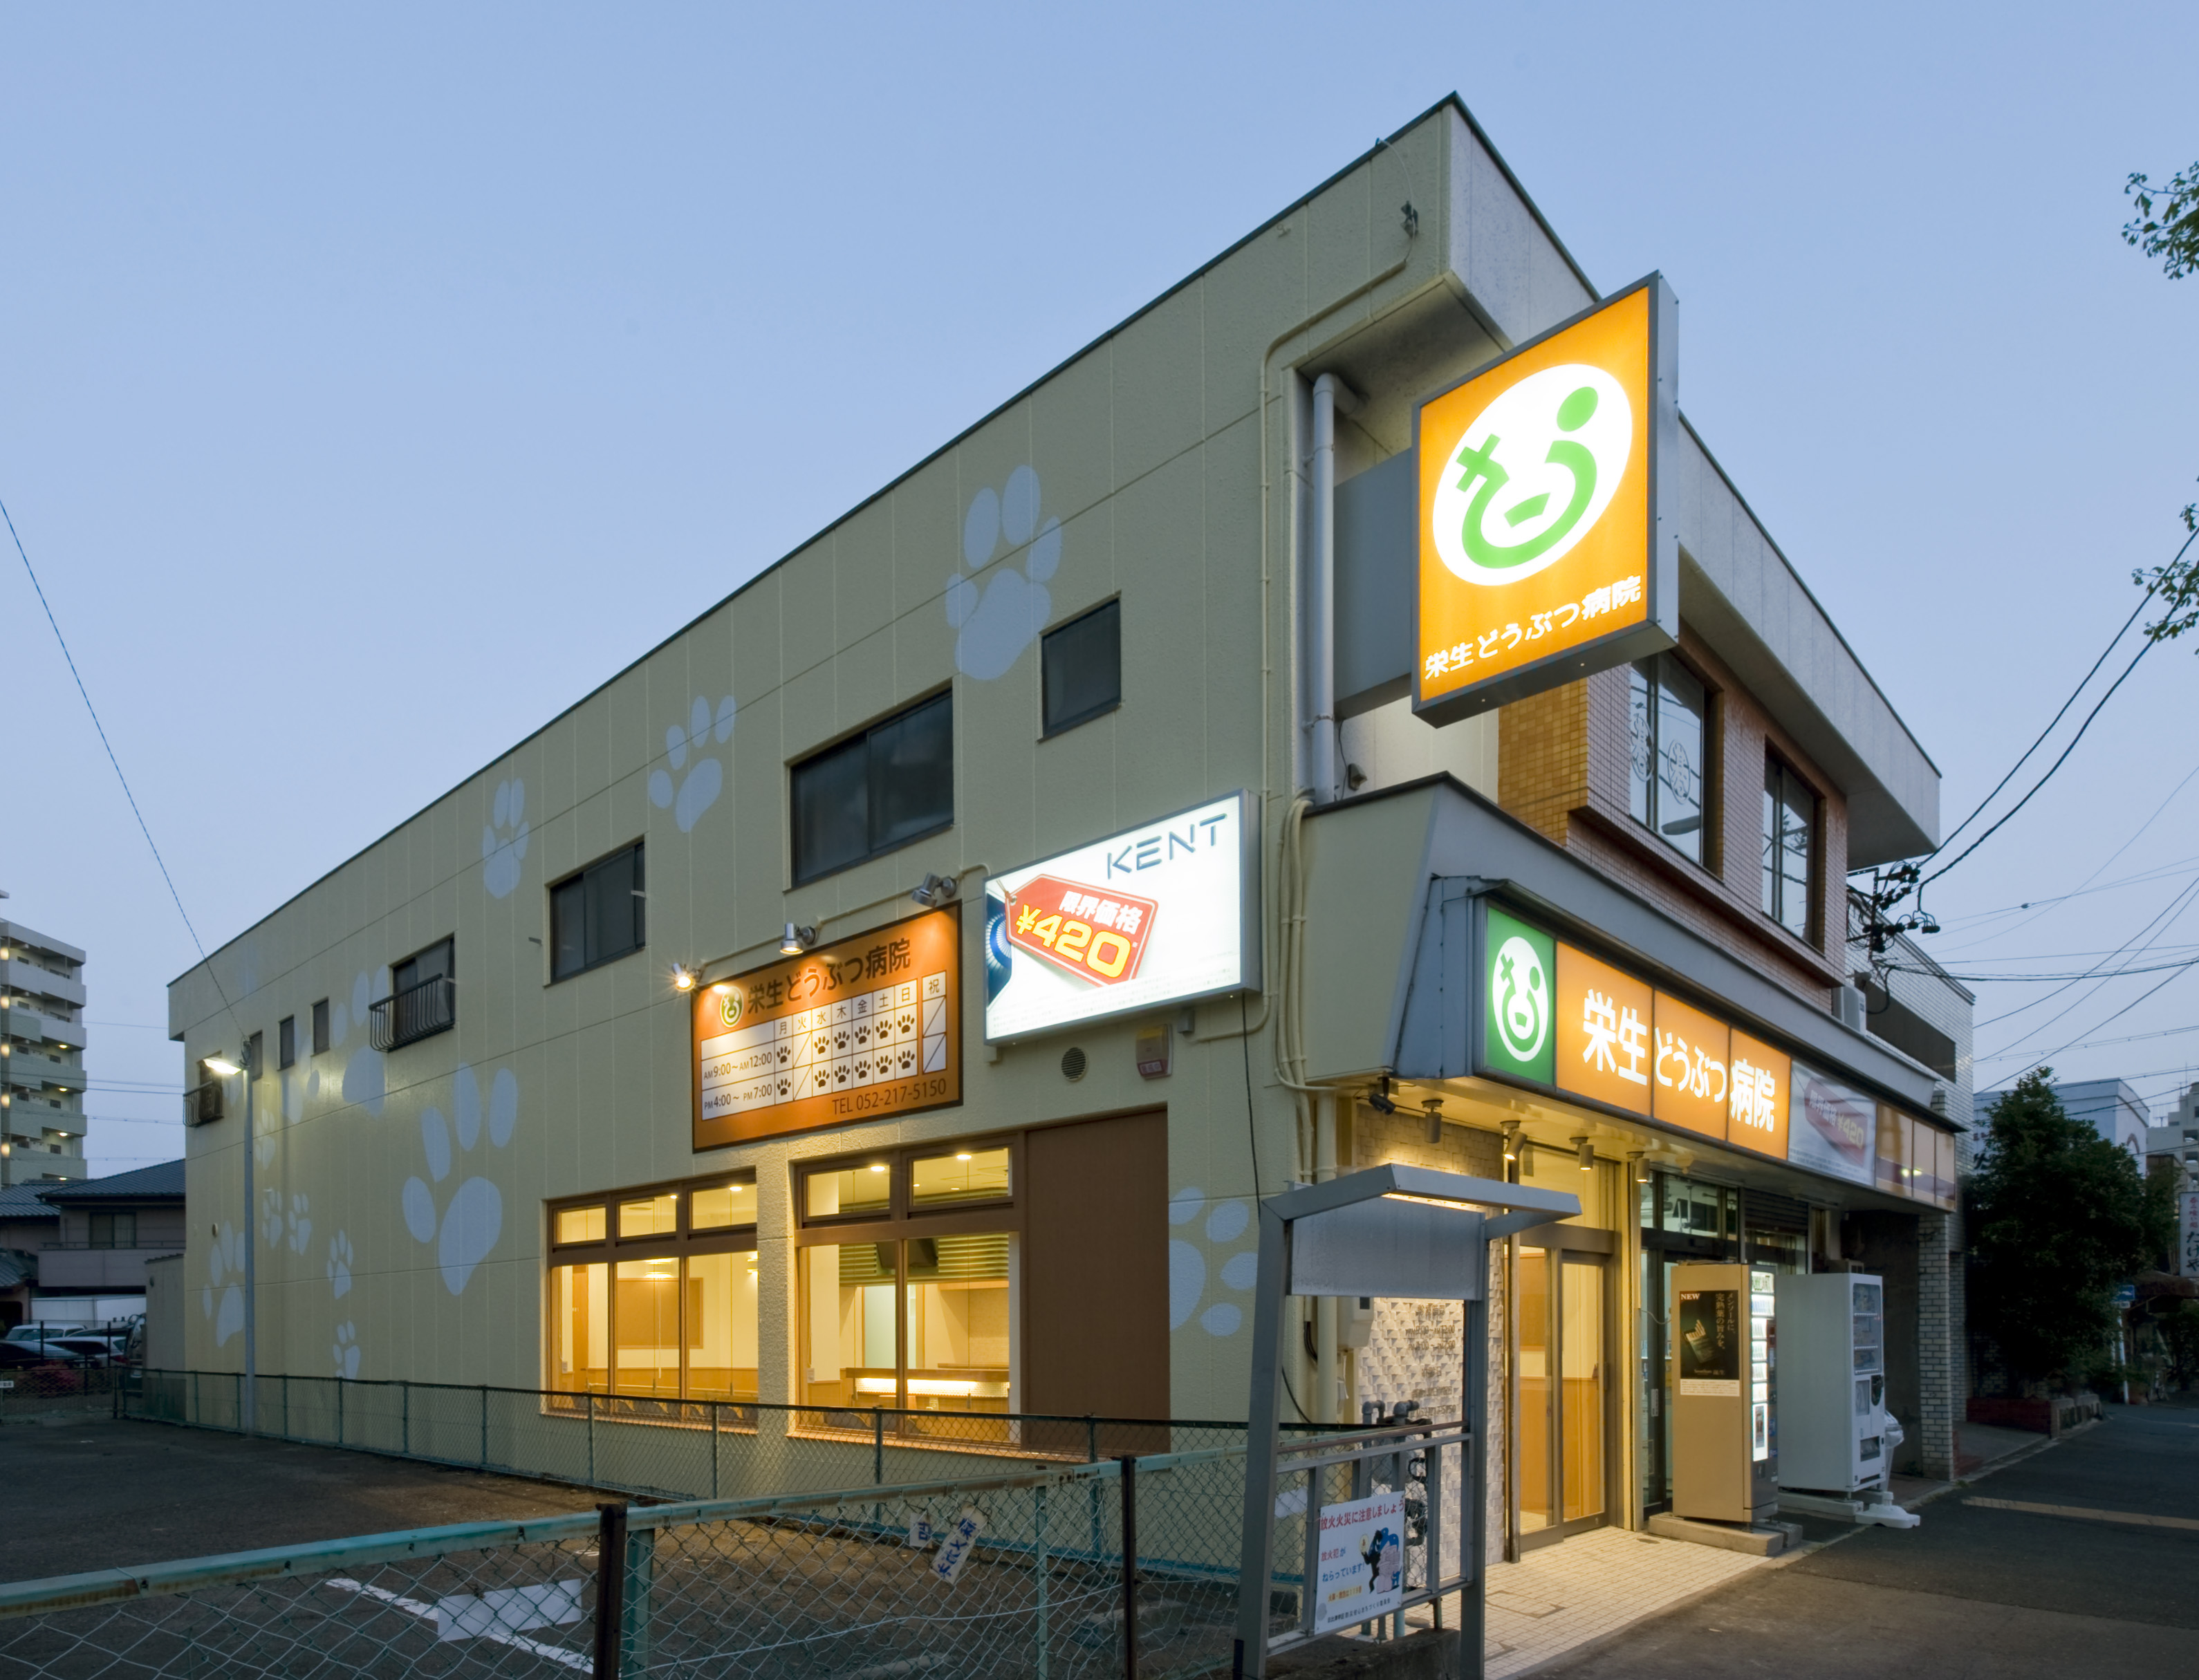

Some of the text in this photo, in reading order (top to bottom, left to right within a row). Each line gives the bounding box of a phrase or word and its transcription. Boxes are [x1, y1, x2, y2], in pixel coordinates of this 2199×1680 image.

[1425, 575, 1641, 680] 栄生どうぶつ病院
[1107, 813, 1227, 879] KENT
[1059, 890, 1143, 935] 限界価格
[748, 938, 911, 1014] 栄生どうぶつ病院
[779, 978, 940, 1035] 月 火 水 木 金 土 日 祝
[1583, 989, 1775, 1132] 栄生どうぶつ病院
[832, 1078, 947, 1114] TEL 052-217-5150
[1320, 1500, 1404, 1531] 放火火災に注意しましょう
[1321, 1547, 1346, 1562] 放火犯が
